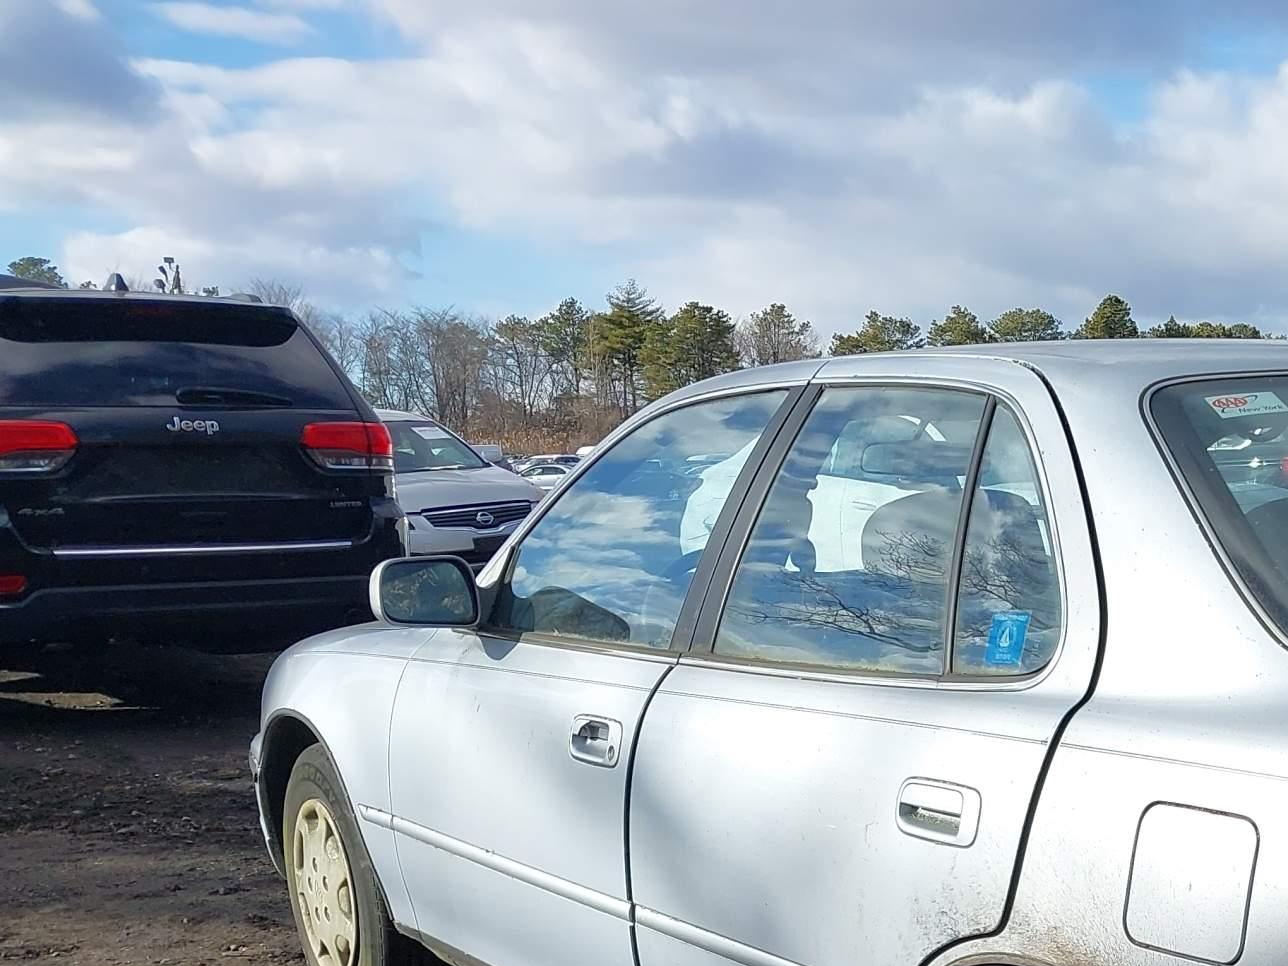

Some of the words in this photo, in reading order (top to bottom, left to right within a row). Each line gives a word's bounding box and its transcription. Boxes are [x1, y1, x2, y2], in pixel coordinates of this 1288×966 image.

[1213, 397, 1247, 408] AAA
[1262, 404, 1284, 412] York
[166, 416, 219, 435] Jeep
